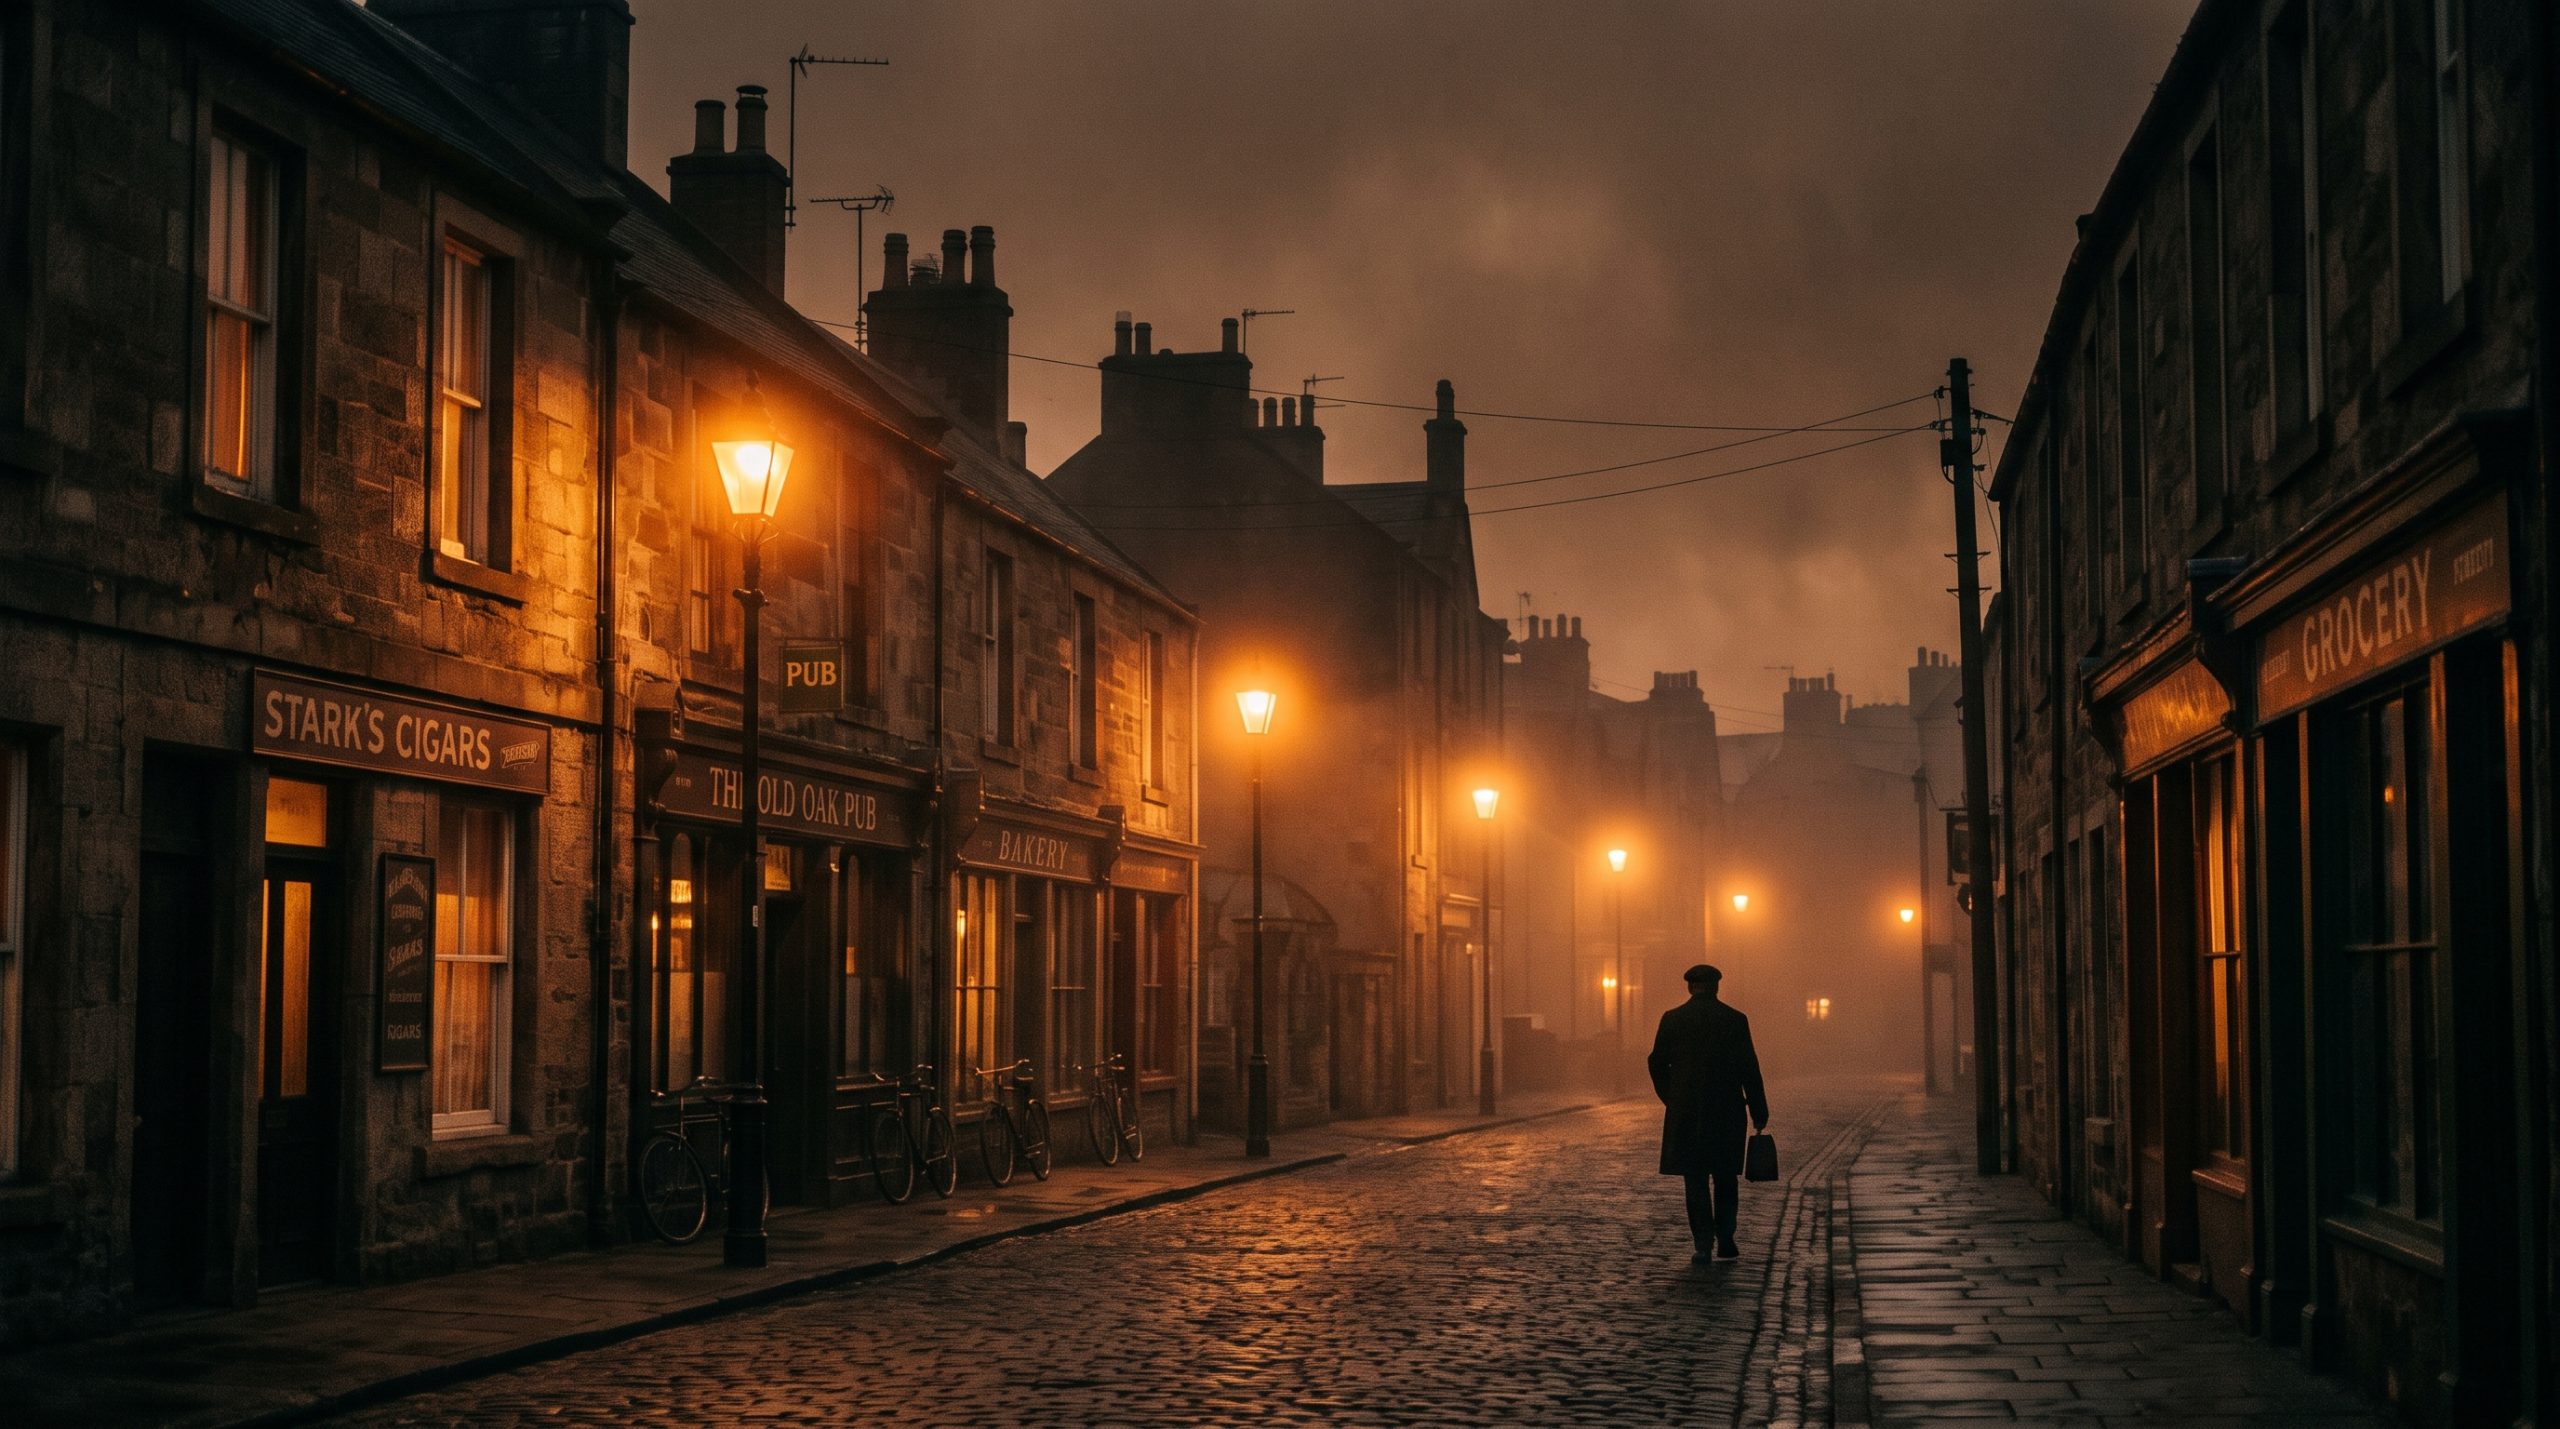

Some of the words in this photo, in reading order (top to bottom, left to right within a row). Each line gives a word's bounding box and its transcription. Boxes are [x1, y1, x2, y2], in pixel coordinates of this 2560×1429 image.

[2302, 545, 2433, 683] GROCERY
[786, 661, 838, 687] PUB
[264, 690, 385, 754] STARK'S
[395, 714, 491, 771] CIGARS
[710, 766, 744, 810] TH
[757, 775, 796, 818] OLD
[802, 784, 840, 826] OAK
[844, 792, 877, 832] PUB
[998, 830, 1069, 870] BAKERY
